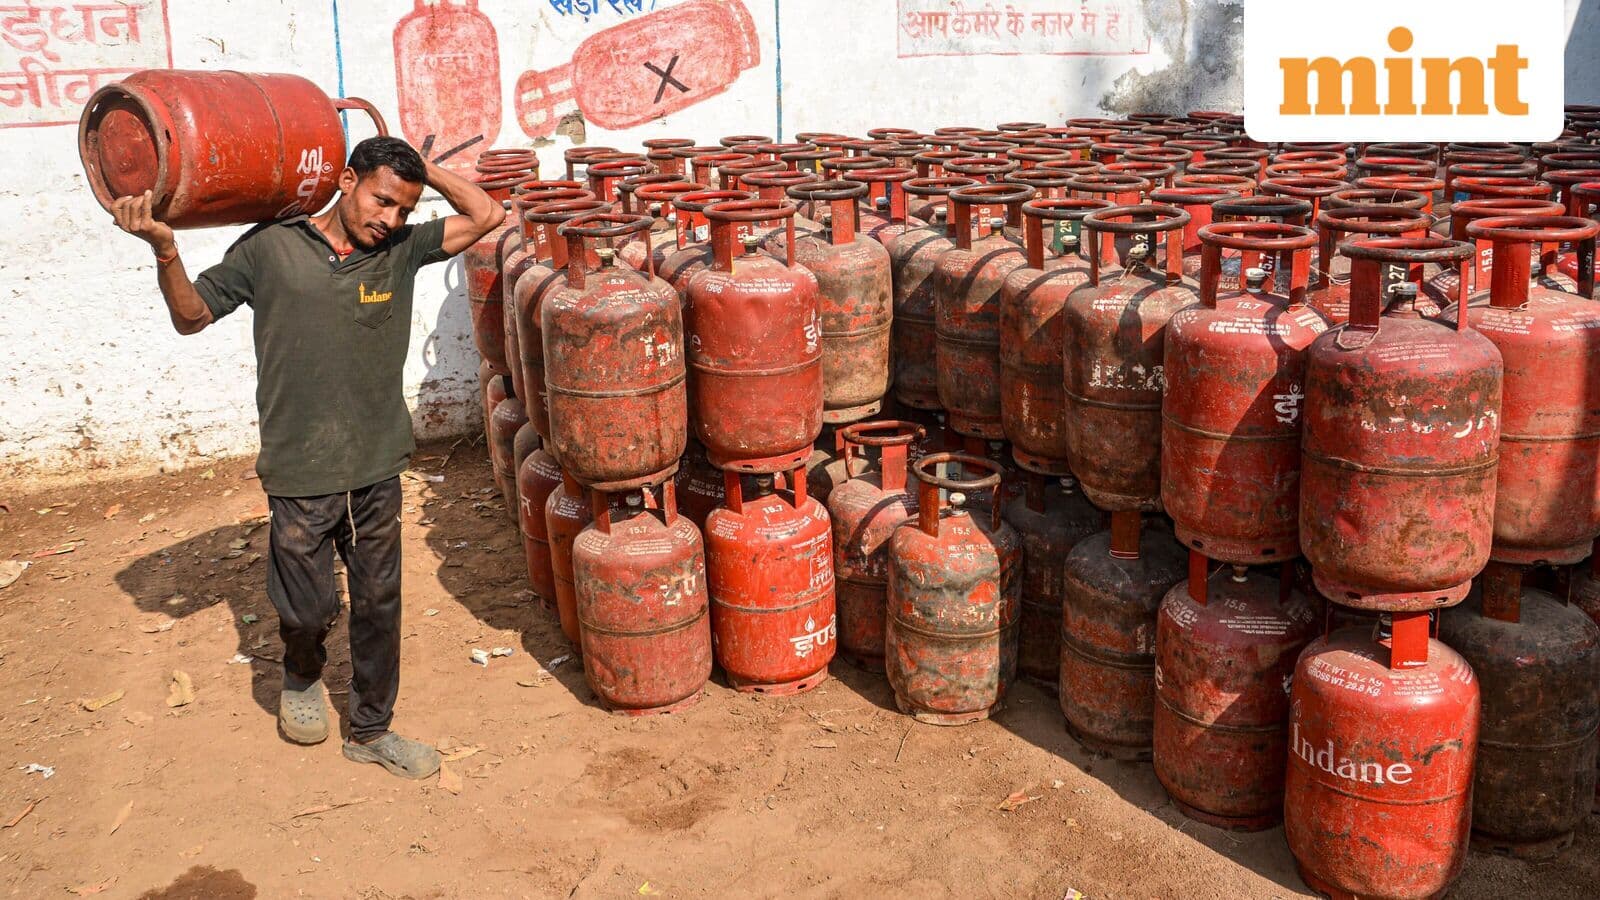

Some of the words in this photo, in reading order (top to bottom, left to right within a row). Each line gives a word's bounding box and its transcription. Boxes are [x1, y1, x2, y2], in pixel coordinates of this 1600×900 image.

[901, 11, 949, 39] आप
[1006, 4, 1024, 40] के
[1481, 247, 1493, 273] 15.8
[1236, 301, 1261, 310] 15.7
[629, 526, 648, 535] 15.7
[1223, 598, 1247, 612] 15.6
[1307, 665, 1331, 682] GROSS
[1330, 678, 1345, 687] WT.
[1331, 665, 1346, 677] WT.
[1292, 722, 1413, 785] Indane
